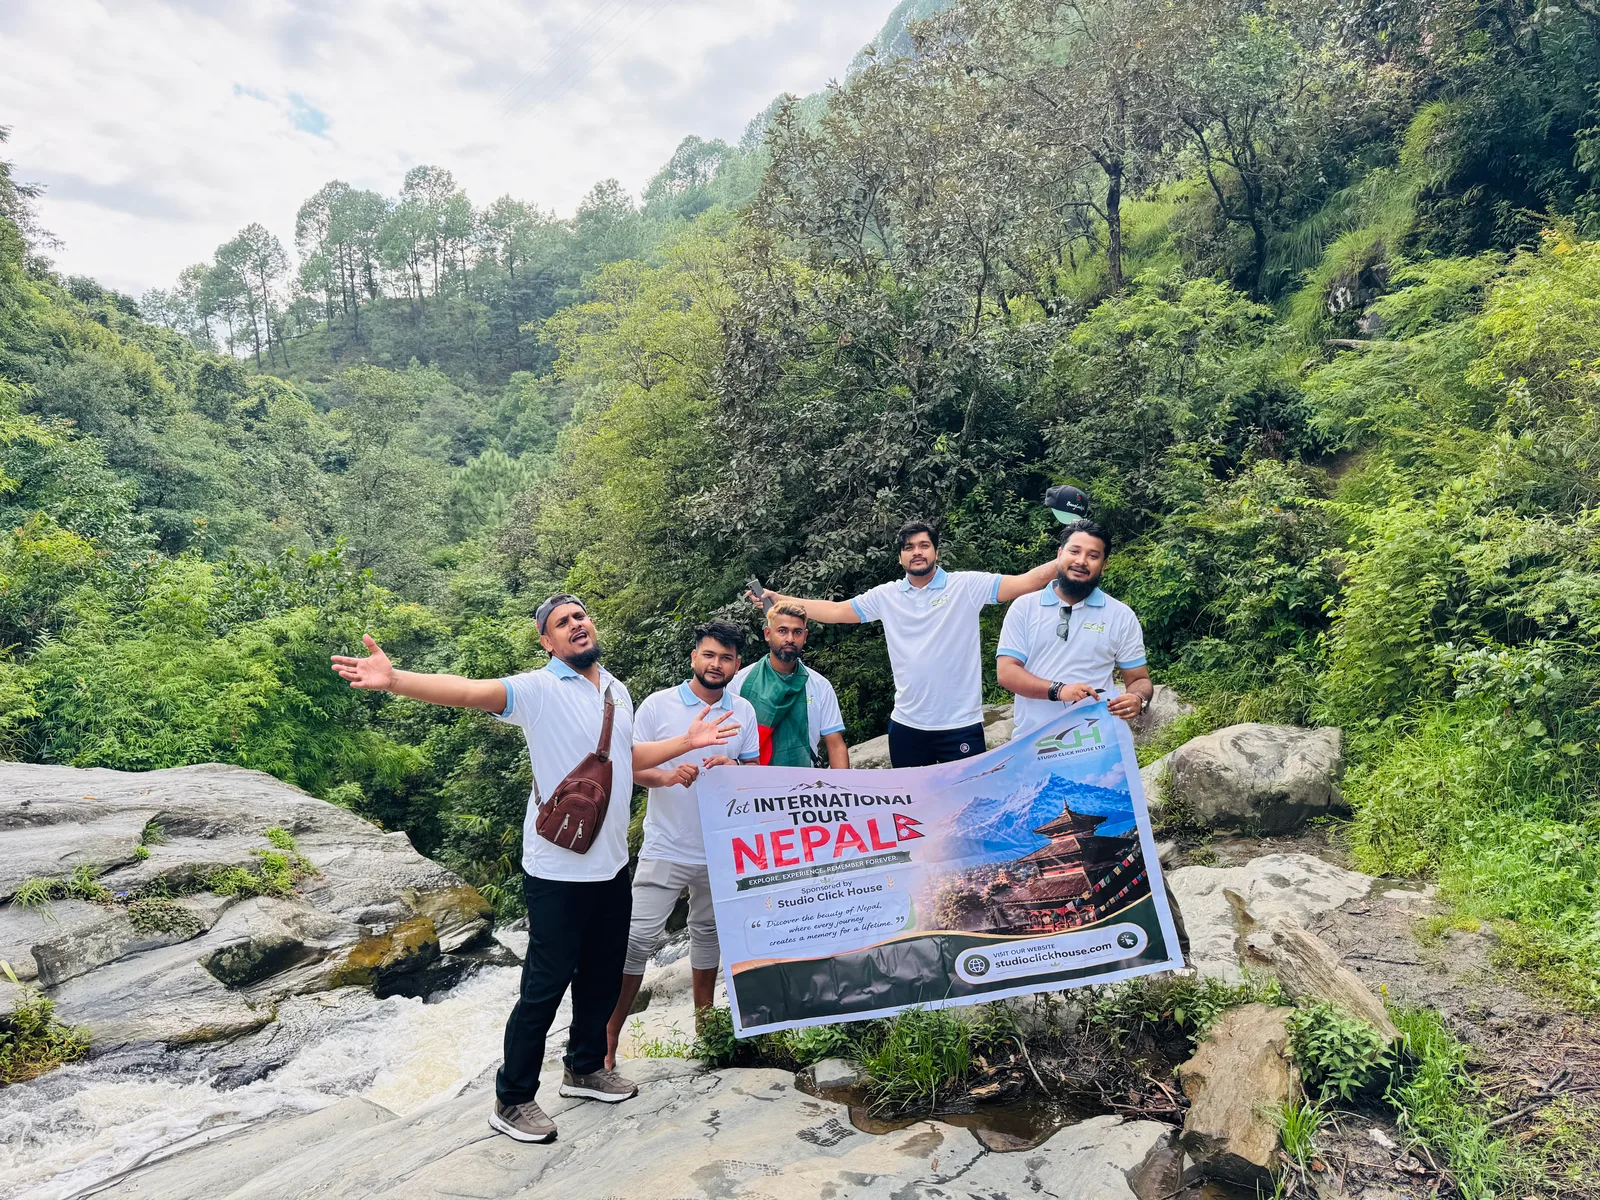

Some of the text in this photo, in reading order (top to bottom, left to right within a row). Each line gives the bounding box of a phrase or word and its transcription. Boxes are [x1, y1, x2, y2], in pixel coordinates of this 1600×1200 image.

[1037, 753, 1058, 761] STUDIO
[1058, 750, 1075, 758] CLICK
[1075, 746, 1095, 754] HOUSE
[726, 793, 915, 817] 1st INTERNATIONAL
[788, 810, 849, 826] TOUR
[731, 818, 897, 875] NEPAL
[748, 855, 899, 886] EXPLORE. EXPERIENCE. REMEMBER FOREVER.
[777, 883, 883, 909] Studio Click House
[801, 878, 853, 895] Sponsored by
[766, 901, 882, 928] Discover the beauty of Nepal,
[788, 915, 865, 934] where every journey
[769, 937, 796, 947] creates
[806, 929, 838, 941] memory
[839, 926, 851, 937] for
[861, 919, 893, 931] lifetime.
[992, 943, 1056, 958] VISIT OUR WEBSITE
[995, 942, 1112, 969] studioclickhouse.com
